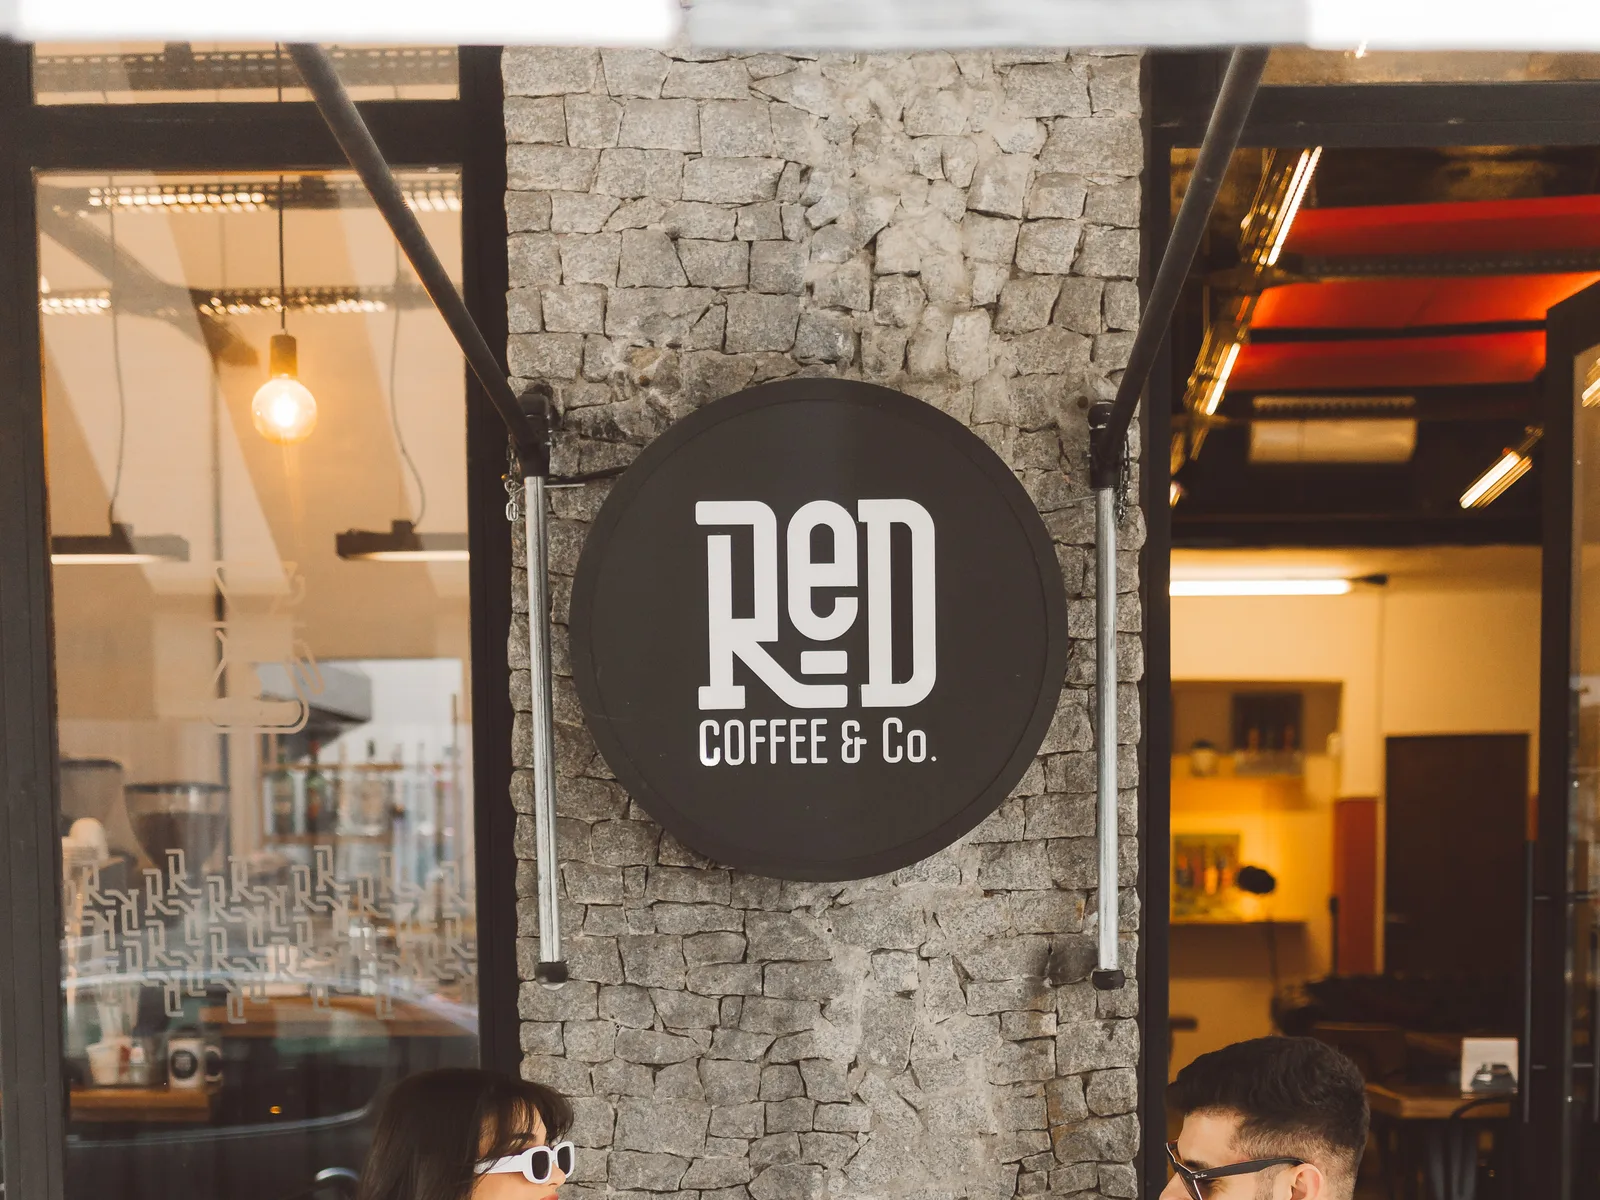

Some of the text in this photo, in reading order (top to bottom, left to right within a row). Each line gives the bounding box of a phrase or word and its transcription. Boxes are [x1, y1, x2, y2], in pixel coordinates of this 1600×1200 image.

[699, 717, 937, 767] COFFEE & Co.
